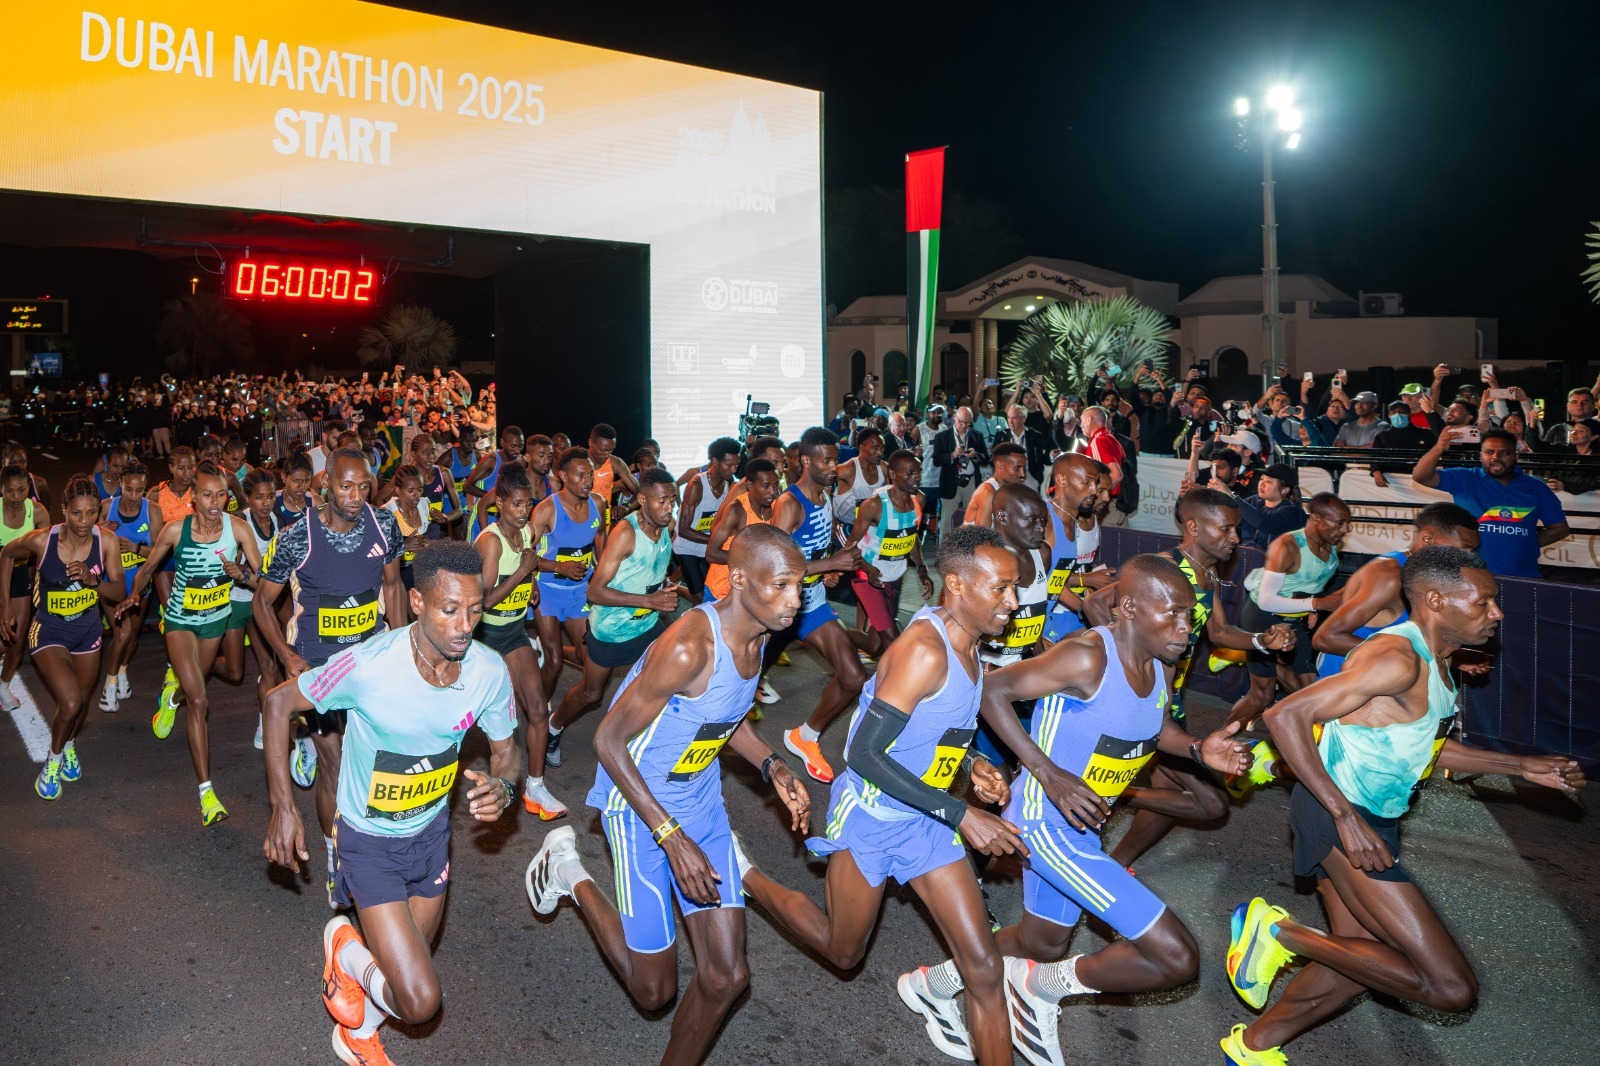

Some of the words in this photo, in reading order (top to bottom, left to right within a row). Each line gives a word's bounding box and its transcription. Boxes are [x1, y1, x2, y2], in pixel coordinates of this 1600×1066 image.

[80, 11, 214, 78] DUBAI
[233, 36, 444, 112] MARATHON
[457, 72, 546, 127] 2025
[272, 107, 398, 166] START
[236, 263, 373, 301] 06:00:02
[729, 286, 778, 306] DUBAI
[671, 345, 697, 360] ITP
[1143, 503, 1175, 516] SPOR
[1478, 523, 1528, 537] ETHIOPIA
[50, 592, 95, 609] HERPHA
[190, 588, 226, 605] YIMER
[322, 609, 375, 629] BIREGA
[1087, 765, 1140, 785] KIPKOE
[373, 772, 453, 801] BEHAILU
